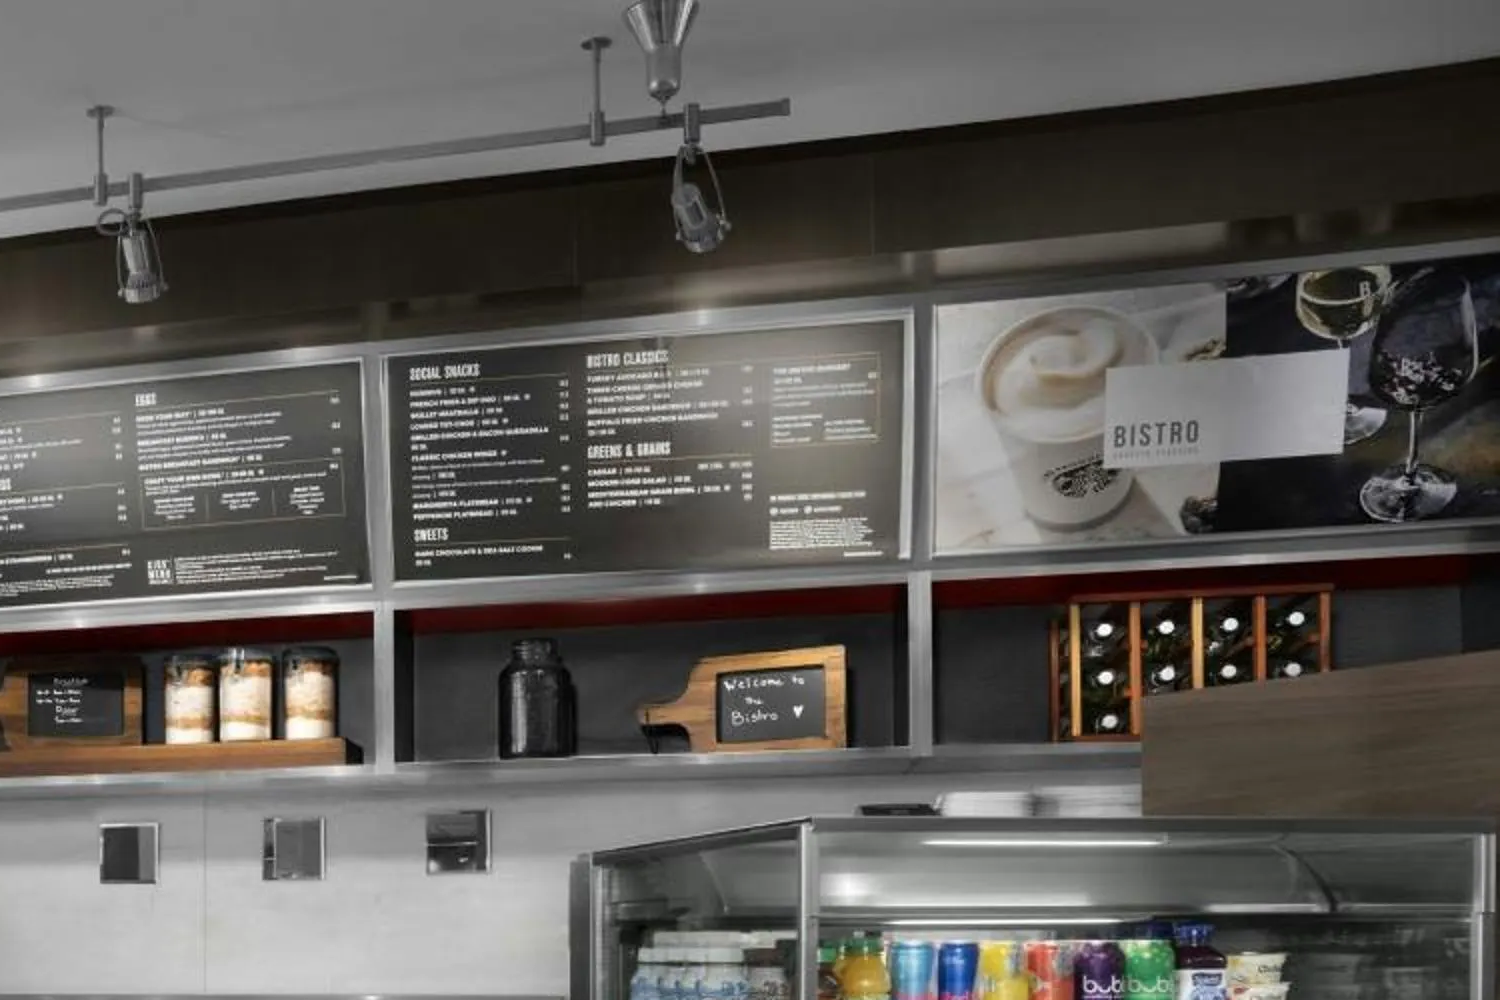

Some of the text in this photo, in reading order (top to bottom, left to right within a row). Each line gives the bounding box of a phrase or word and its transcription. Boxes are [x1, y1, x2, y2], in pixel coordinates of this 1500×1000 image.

[1114, 421, 1199, 449] BISTRO
[723, 677, 784, 692] Welcome
[731, 709, 779, 727] Bistro
